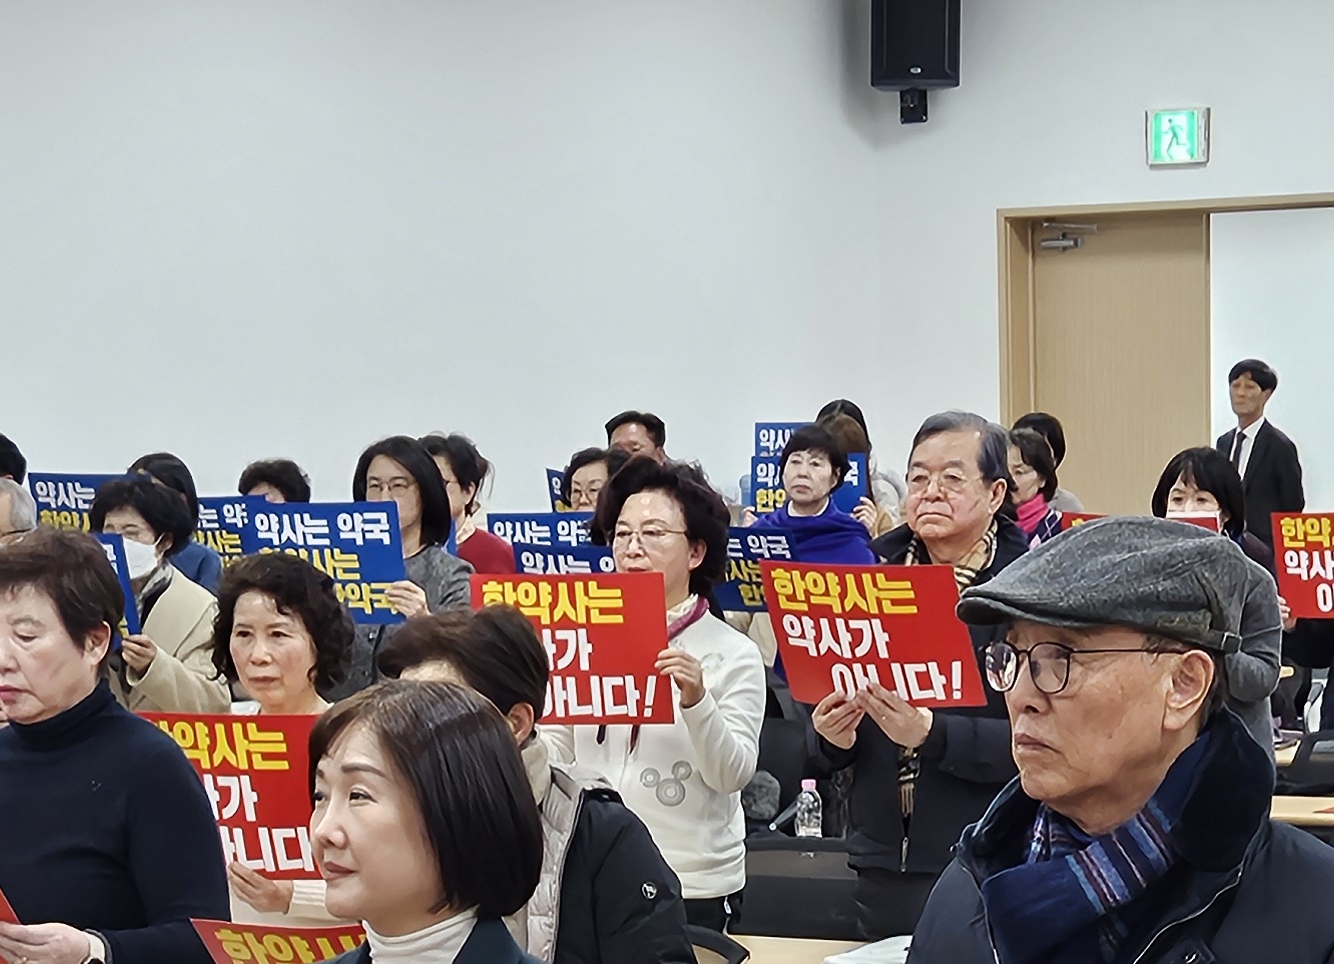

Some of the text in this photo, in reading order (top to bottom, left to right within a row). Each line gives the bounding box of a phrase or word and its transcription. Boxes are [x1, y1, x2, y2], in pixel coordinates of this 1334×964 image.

[35, 481, 96, 510] 약사는
[222, 502, 249, 528] 약
[255, 511, 391, 546] 약사는 약국
[493, 521, 552, 546] 약사는
[748, 535, 792, 559] 약국
[260, 547, 361, 580] 사는
[770, 567, 918, 614] 한약사는
[782, 613, 891, 660] 약사가
[830, 660, 963, 702] 아니다!
[156, 720, 290, 771] 약사는
